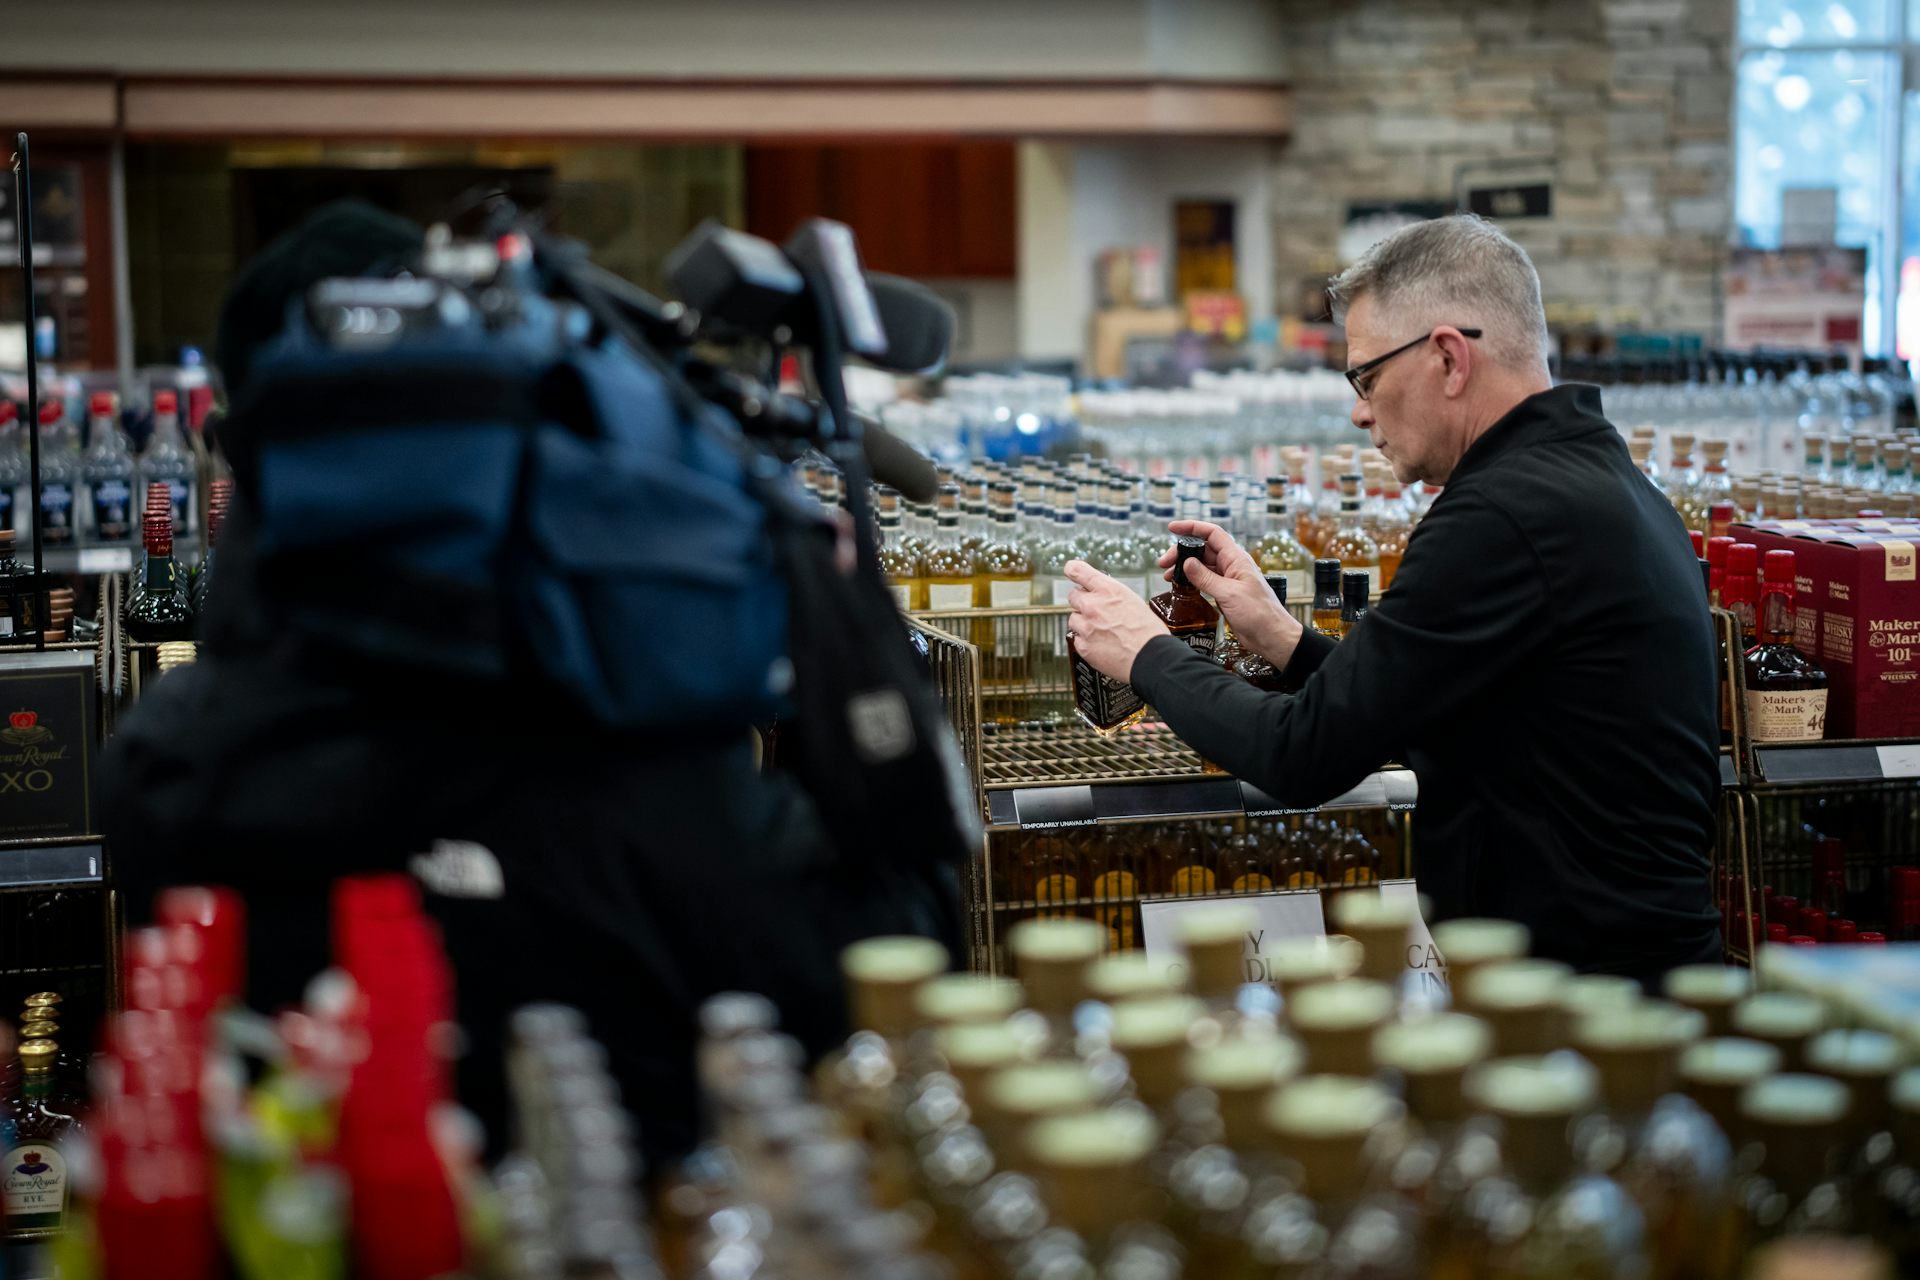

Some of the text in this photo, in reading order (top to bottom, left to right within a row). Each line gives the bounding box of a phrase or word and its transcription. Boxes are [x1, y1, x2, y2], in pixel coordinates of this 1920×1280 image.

[1823, 621, 1853, 639] WHISKY
[1888, 647, 1911, 662] 101
[1762, 696, 1806, 705] Maker's
[1774, 705, 1805, 714] Mark
[17, 745, 68, 767] Royal
[0, 770, 53, 793] XO
[1247, 809, 1283, 818] TEMPORARILY
[1021, 819, 1097, 830] TEMPORARILY UNAVAILABLE
[4, 1175, 62, 1190] Crown Royal
